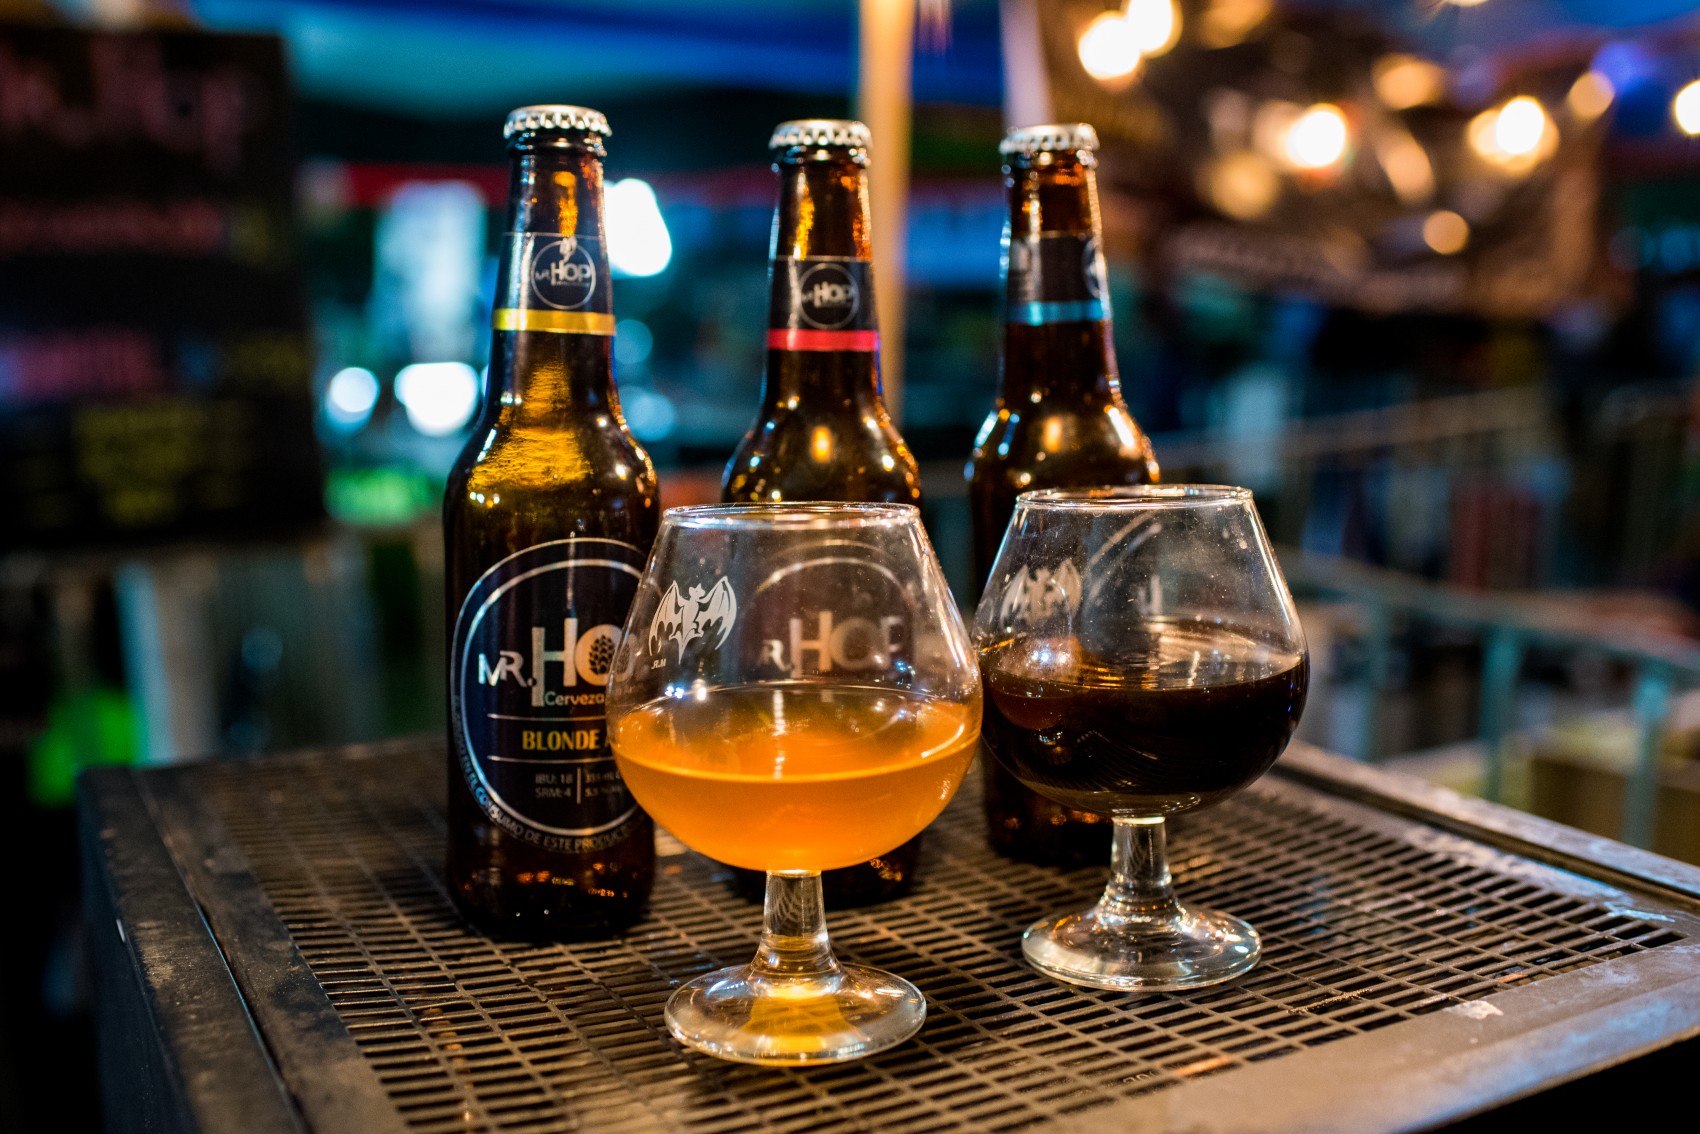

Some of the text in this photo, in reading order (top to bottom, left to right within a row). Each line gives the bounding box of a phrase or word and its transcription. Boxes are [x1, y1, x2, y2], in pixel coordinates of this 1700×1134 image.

[550, 260, 591, 286] HOP
[531, 617, 637, 707] HO
[522, 730, 600, 750] BLONDE
[475, 786, 524, 836] CONSUMO
[525, 829, 541, 845] DE
[543, 834, 574, 850] ESTE
